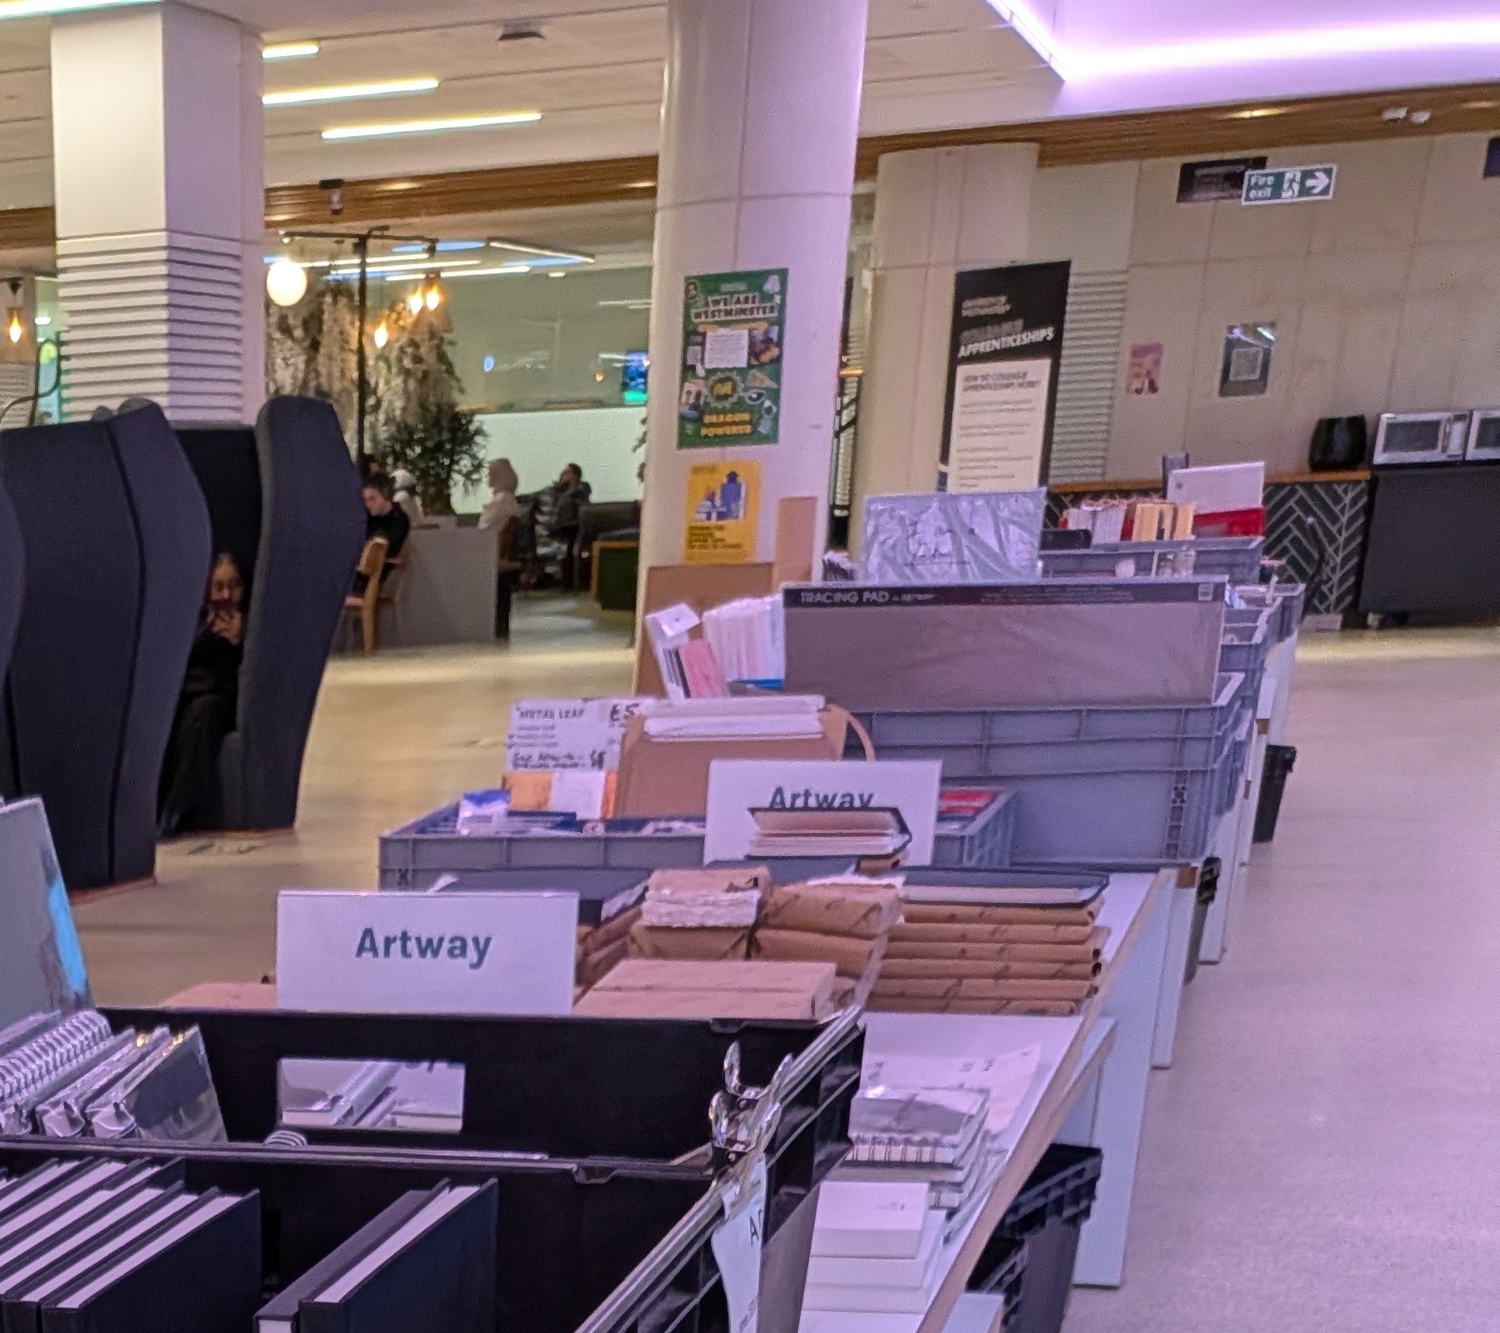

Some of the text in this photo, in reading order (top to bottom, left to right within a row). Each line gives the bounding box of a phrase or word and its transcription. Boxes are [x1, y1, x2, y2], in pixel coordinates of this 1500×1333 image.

[1251, 175, 1274, 186] Fire
[1250, 187, 1273, 199] exit
[957, 326, 1055, 358] APPRENTICESHIPS
[800, 590, 860, 604] TRACING
[862, 590, 890, 603] PAD
[355, 926, 493, 970] Artway
